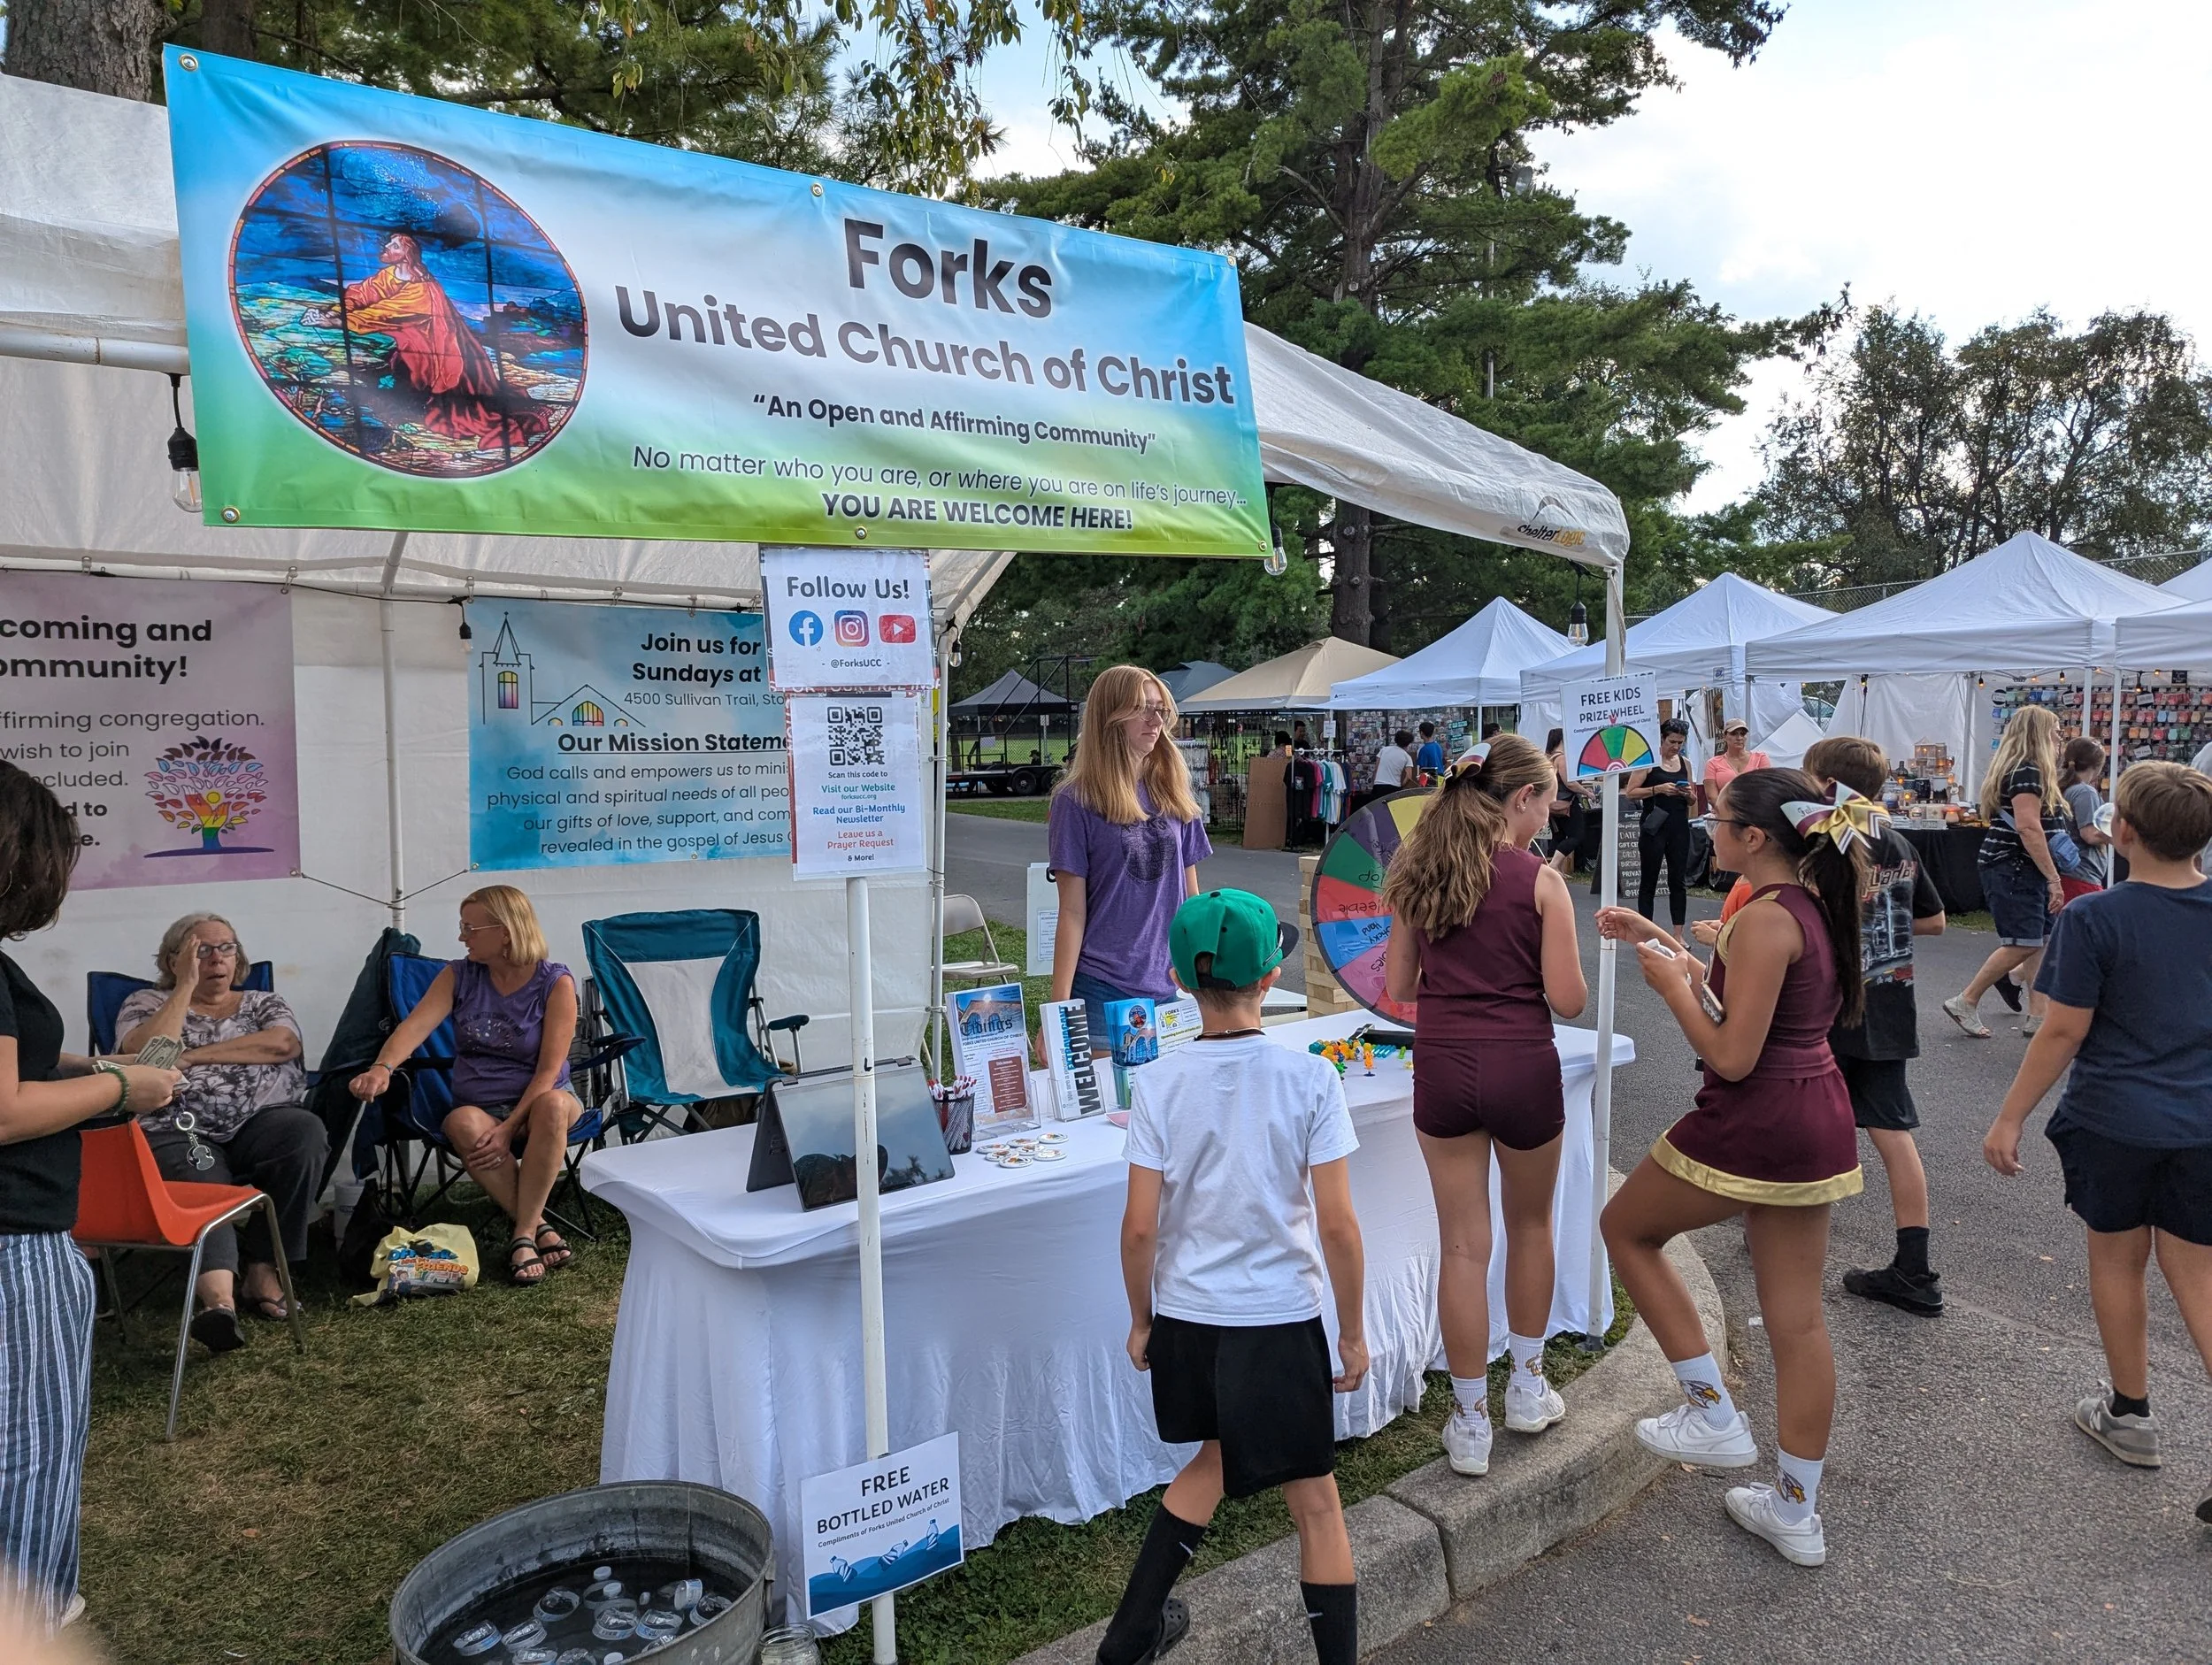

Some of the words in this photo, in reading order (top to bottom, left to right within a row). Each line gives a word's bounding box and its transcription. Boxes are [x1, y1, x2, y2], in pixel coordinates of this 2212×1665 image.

[841, 219, 1053, 318] Forks
[615, 285, 826, 359] United
[838, 322, 1033, 385] Church
[1043, 349, 1087, 393] of
[1097, 355, 1235, 405] Christ
[809, 399, 874, 428] Open
[879, 405, 924, 427] and
[930, 409, 1030, 444] Affirming
[634, 446, 671, 470] No
[680, 450, 766, 476] matter
[774, 456, 824, 480] who
[831, 463, 873, 487] you
[879, 464, 921, 487] are,
[928, 470, 951, 488] or
[957, 468, 1023, 492] where
[1028, 476, 1063, 497] you
[1068, 478, 1096, 495] are
[1103, 479, 1126, 497] on
[821, 494, 881, 518] YOU
[887, 496, 937, 521] ARE
[943, 501, 1065, 527] WELCOME
[1070, 507, 1133, 530] HERE!
[787, 576, 866, 599] Follow
[875, 579, 910, 600] Us!
[146, 620, 212, 641] and
[641, 633, 691, 653] Join
[698, 637, 724, 654] us
[730, 636, 761, 656] for
[0, 654, 188, 685] mmunity!
[830, 658, 882, 668] @ForksUCC
[633, 663, 733, 687] Sundays
[739, 666, 761, 682] at
[624, 692, 660, 705] 4500
[665, 693, 721, 706] Sullivan
[725, 694, 759, 707] Trail,
[763, 694, 785, 706] Sto
[1580, 692, 1610, 706] FREE
[1614, 687, 1640, 702] KIDS
[99, 710, 265, 731] congregation.
[1579, 710, 1609, 724] PRIZE
[1610, 705, 1644, 717] WHEEL
[0, 742, 52, 759] wish
[60, 742, 82, 758] to
[88, 741, 129, 762] join
[558, 733, 603, 752] Our
[609, 732, 699, 751] Mission
[705, 734, 787, 751] Statem
[35, 771, 128, 787] cluded.
[507, 766, 544, 780] God
[549, 766, 588, 779] calls
[593, 764, 626, 779] and
[630, 763, 713, 782] empowers
[717, 765, 733, 776] us
[737, 763, 751, 776] to
[755, 762, 788, 775] mini
[488, 790, 560, 809] physical
[566, 790, 600, 805] and
[604, 788, 667, 807] spiritual
[672, 788, 717, 802] needs
[721, 786, 736, 799] of
[738, 786, 756, 798] all
[761, 786, 788, 801] peo
[821, 784, 841, 793] Visit
[861, 783, 895, 792] Website
[84, 802, 107, 817] to
[813, 806, 834, 815] Read
[856, 803, 905, 815] Bi-Monthly
[836, 814, 884, 825] Newsletter
[524, 817, 551, 831] our
[557, 814, 593, 832] gifts
[597, 814, 612, 828] of
[618, 812, 653, 828] love,
[657, 809, 719, 827] support,
[724, 809, 753, 822] and
[758, 810, 790, 821] com
[541, 839, 613, 854] revealed
[618, 838, 633, 850] in
[637, 836, 663, 849] the
[667, 832, 719, 851] gospel
[724, 832, 739, 846] of
[742, 831, 783, 844] Jesus
[827, 840, 857, 850] Prayer
[859, 838, 894, 848] Request
[838, 830, 863, 839] Leave
[1339, 901, 1392, 913] eeble
[1066, 1004, 1102, 1115] WELCOME
[415, 1262, 469, 1275] FRIENDS
[861, 1466, 910, 1497] FREE
[817, 1500, 893, 1534] BOTTLED
[897, 1477, 949, 1508] WATER
[818, 1531, 859, 1548] Compliments
[869, 1523, 885, 1533] Forks
[887, 1517, 905, 1527] United
[906, 1508, 926, 1519] Church
[933, 1498, 949, 1508] Christ
